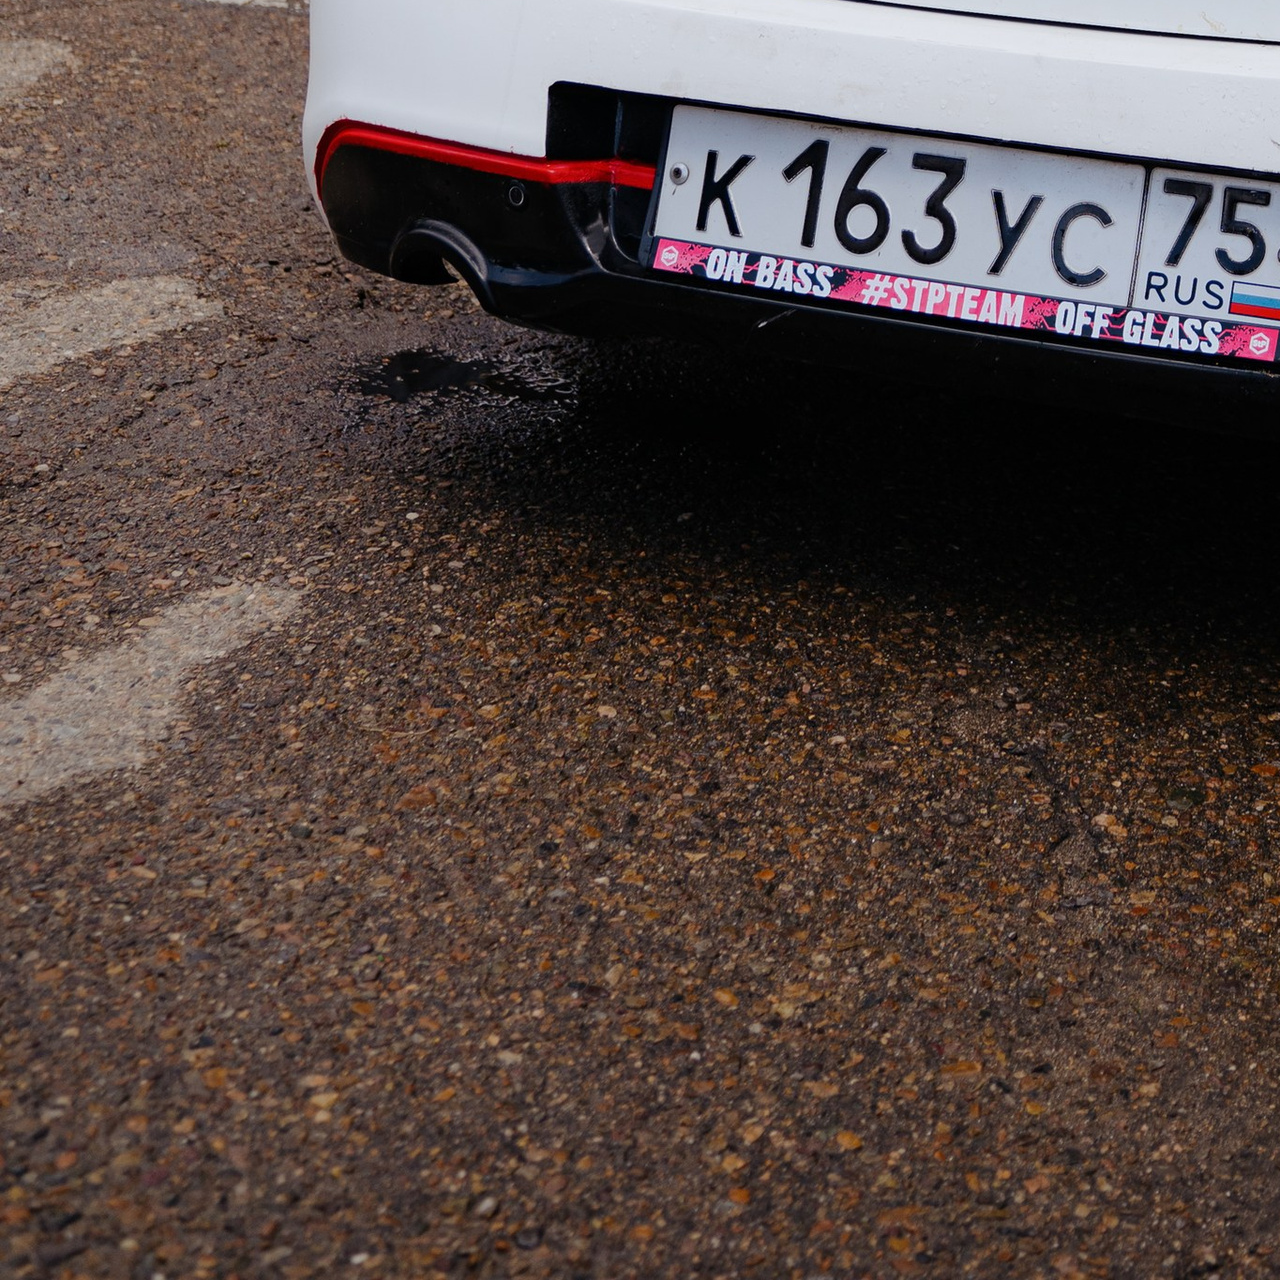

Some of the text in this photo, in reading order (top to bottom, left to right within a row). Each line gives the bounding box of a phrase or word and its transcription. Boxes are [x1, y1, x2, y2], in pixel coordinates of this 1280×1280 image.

[1162, 179, 1271, 276] 75
[706, 247, 1224, 355] ON BASS #STPTEAM OFF GLASS
[1145, 271, 1226, 311] RUS
